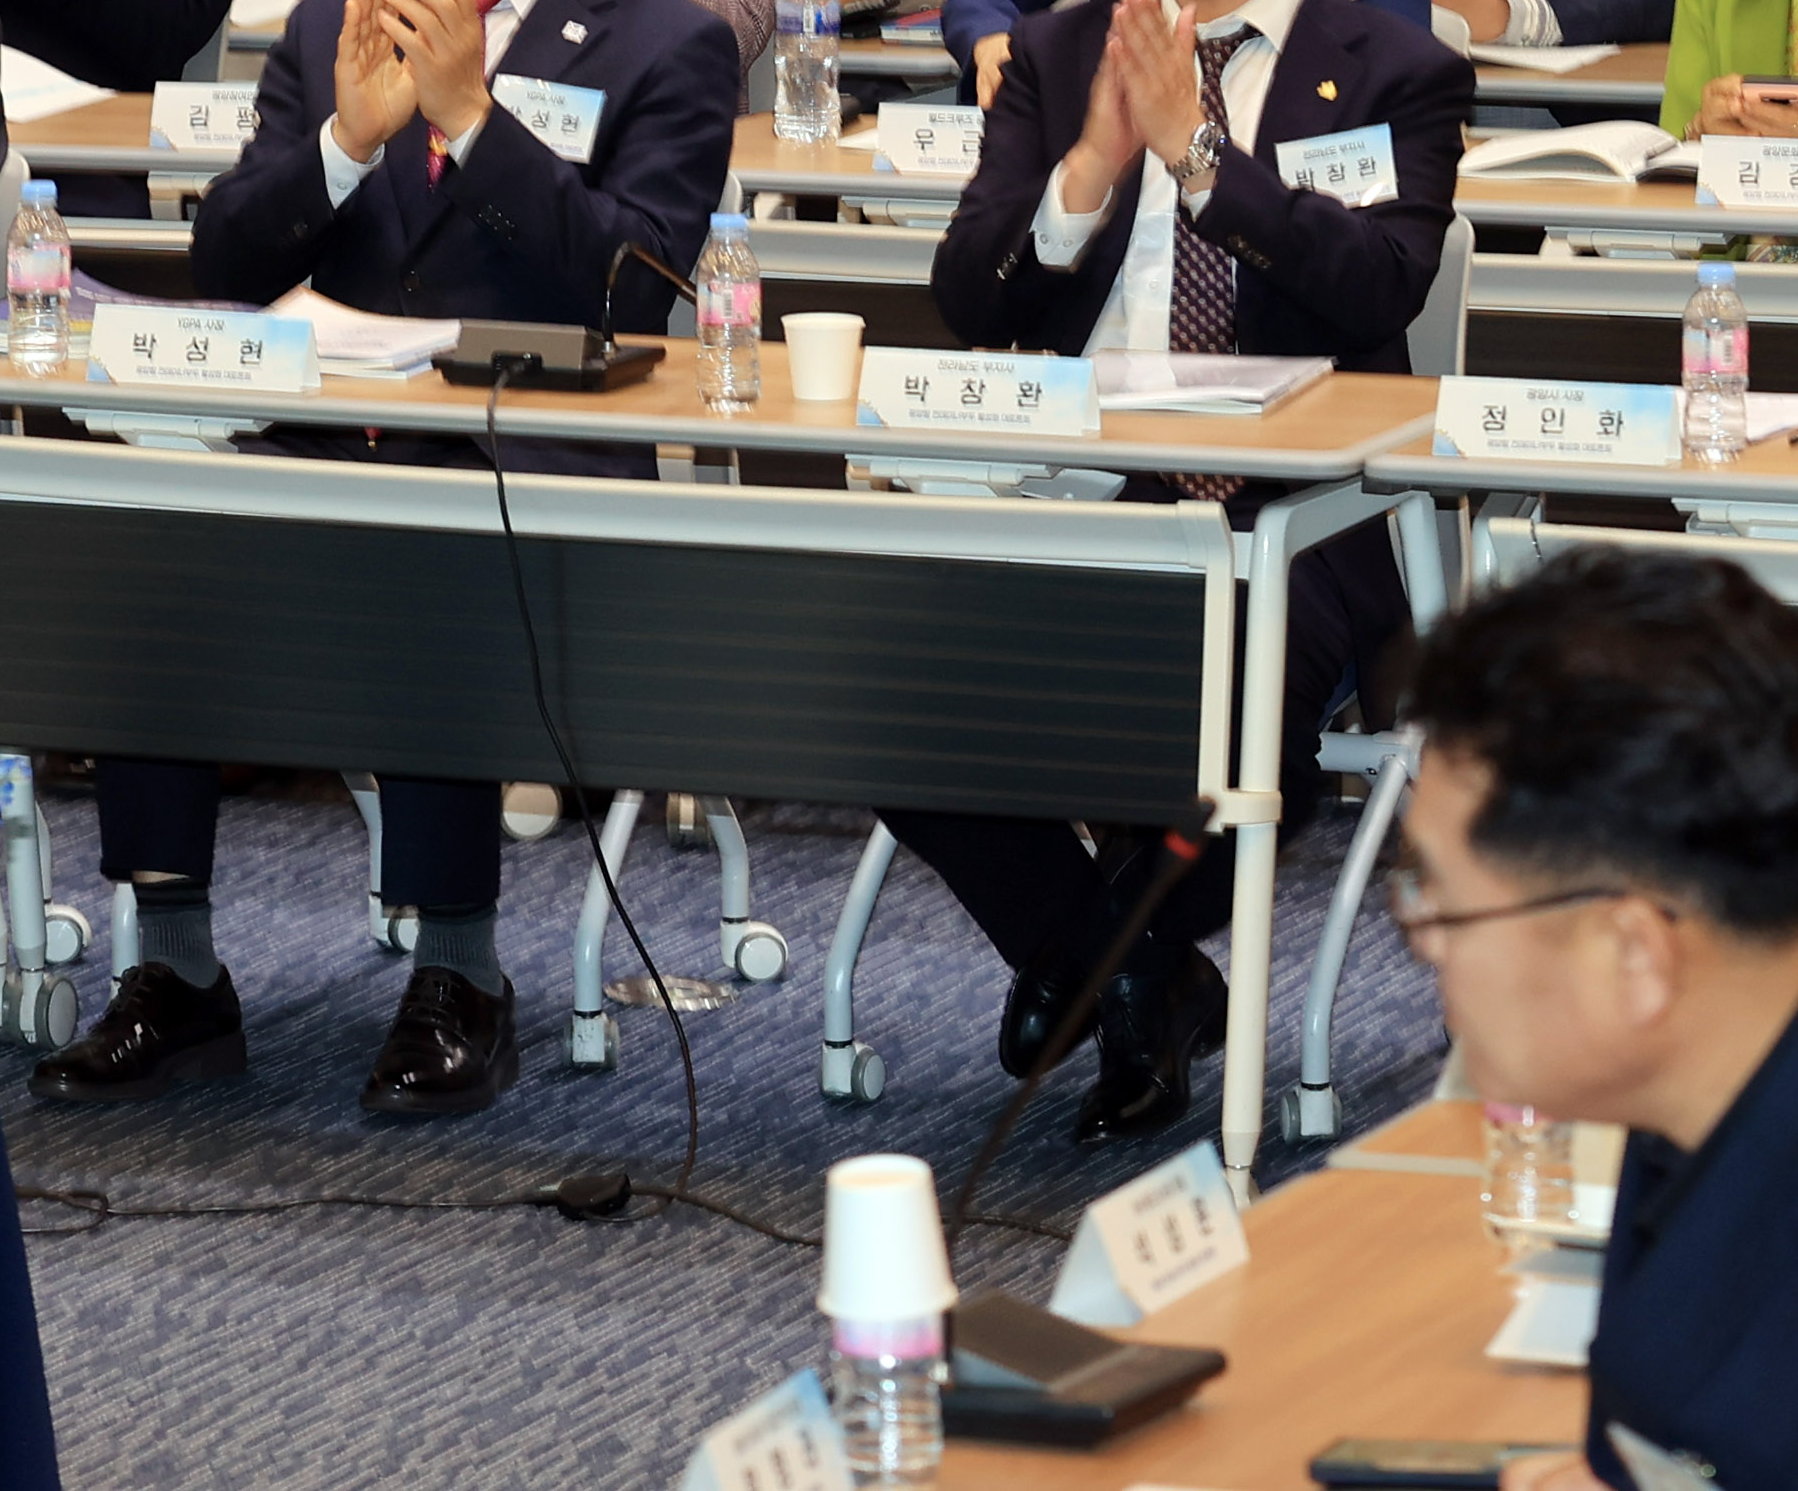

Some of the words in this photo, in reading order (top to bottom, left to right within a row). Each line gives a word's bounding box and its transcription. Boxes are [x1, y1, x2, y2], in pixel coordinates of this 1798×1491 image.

[177, 317, 202, 329] YGPA
[132, 332, 263, 366] 박성현
[904, 375, 1043, 408] 박창환
[1481, 404, 1624, 437] 정인화
